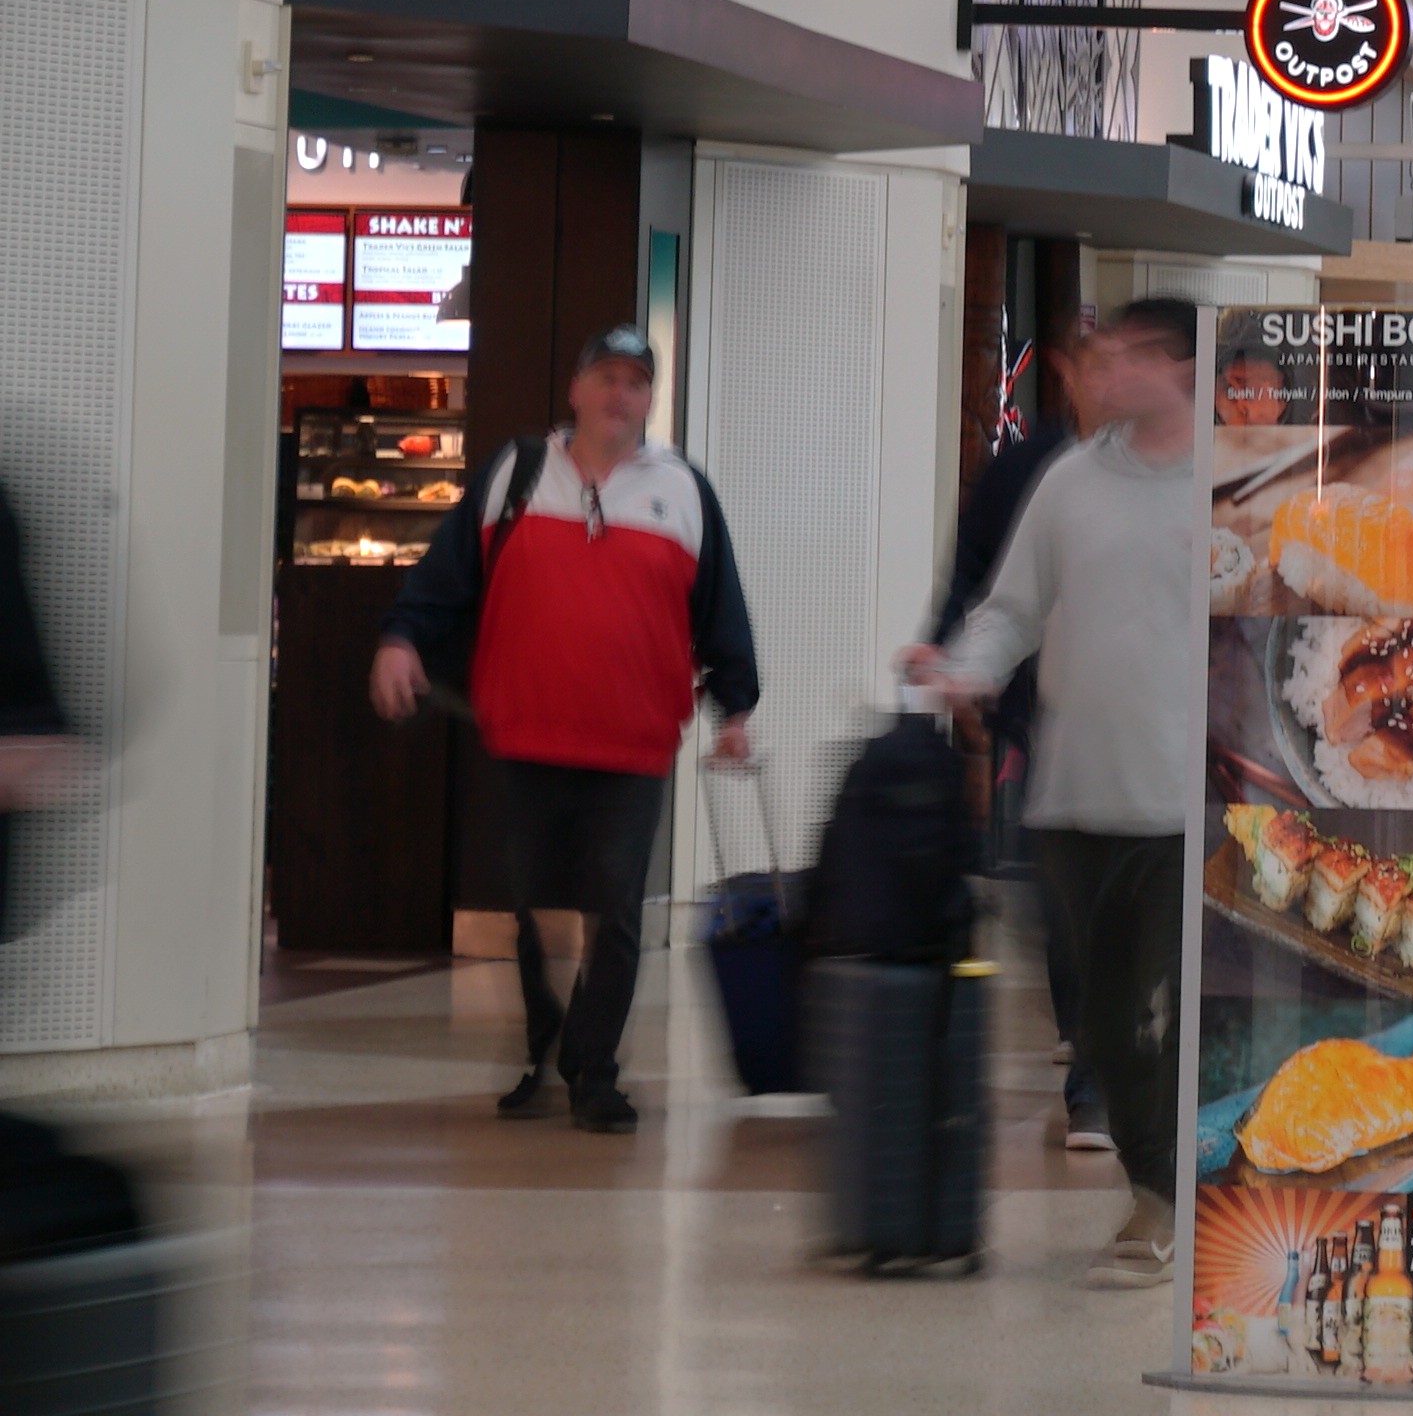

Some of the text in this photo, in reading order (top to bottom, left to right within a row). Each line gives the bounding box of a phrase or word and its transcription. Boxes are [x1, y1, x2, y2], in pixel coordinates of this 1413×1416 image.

[1275, 41, 1377, 88] OUTPOST
[1208, 54, 1284, 180] TRADER
[1254, 172, 1305, 231] OUTPOST
[368, 216, 439, 235] SHAKE
[1261, 313, 1374, 348] SUSHI
[1227, 387, 1255, 401] Sushi
[1267, 388, 1308, 403] Teriyaki
[1363, 388, 1413, 403] Tempura
